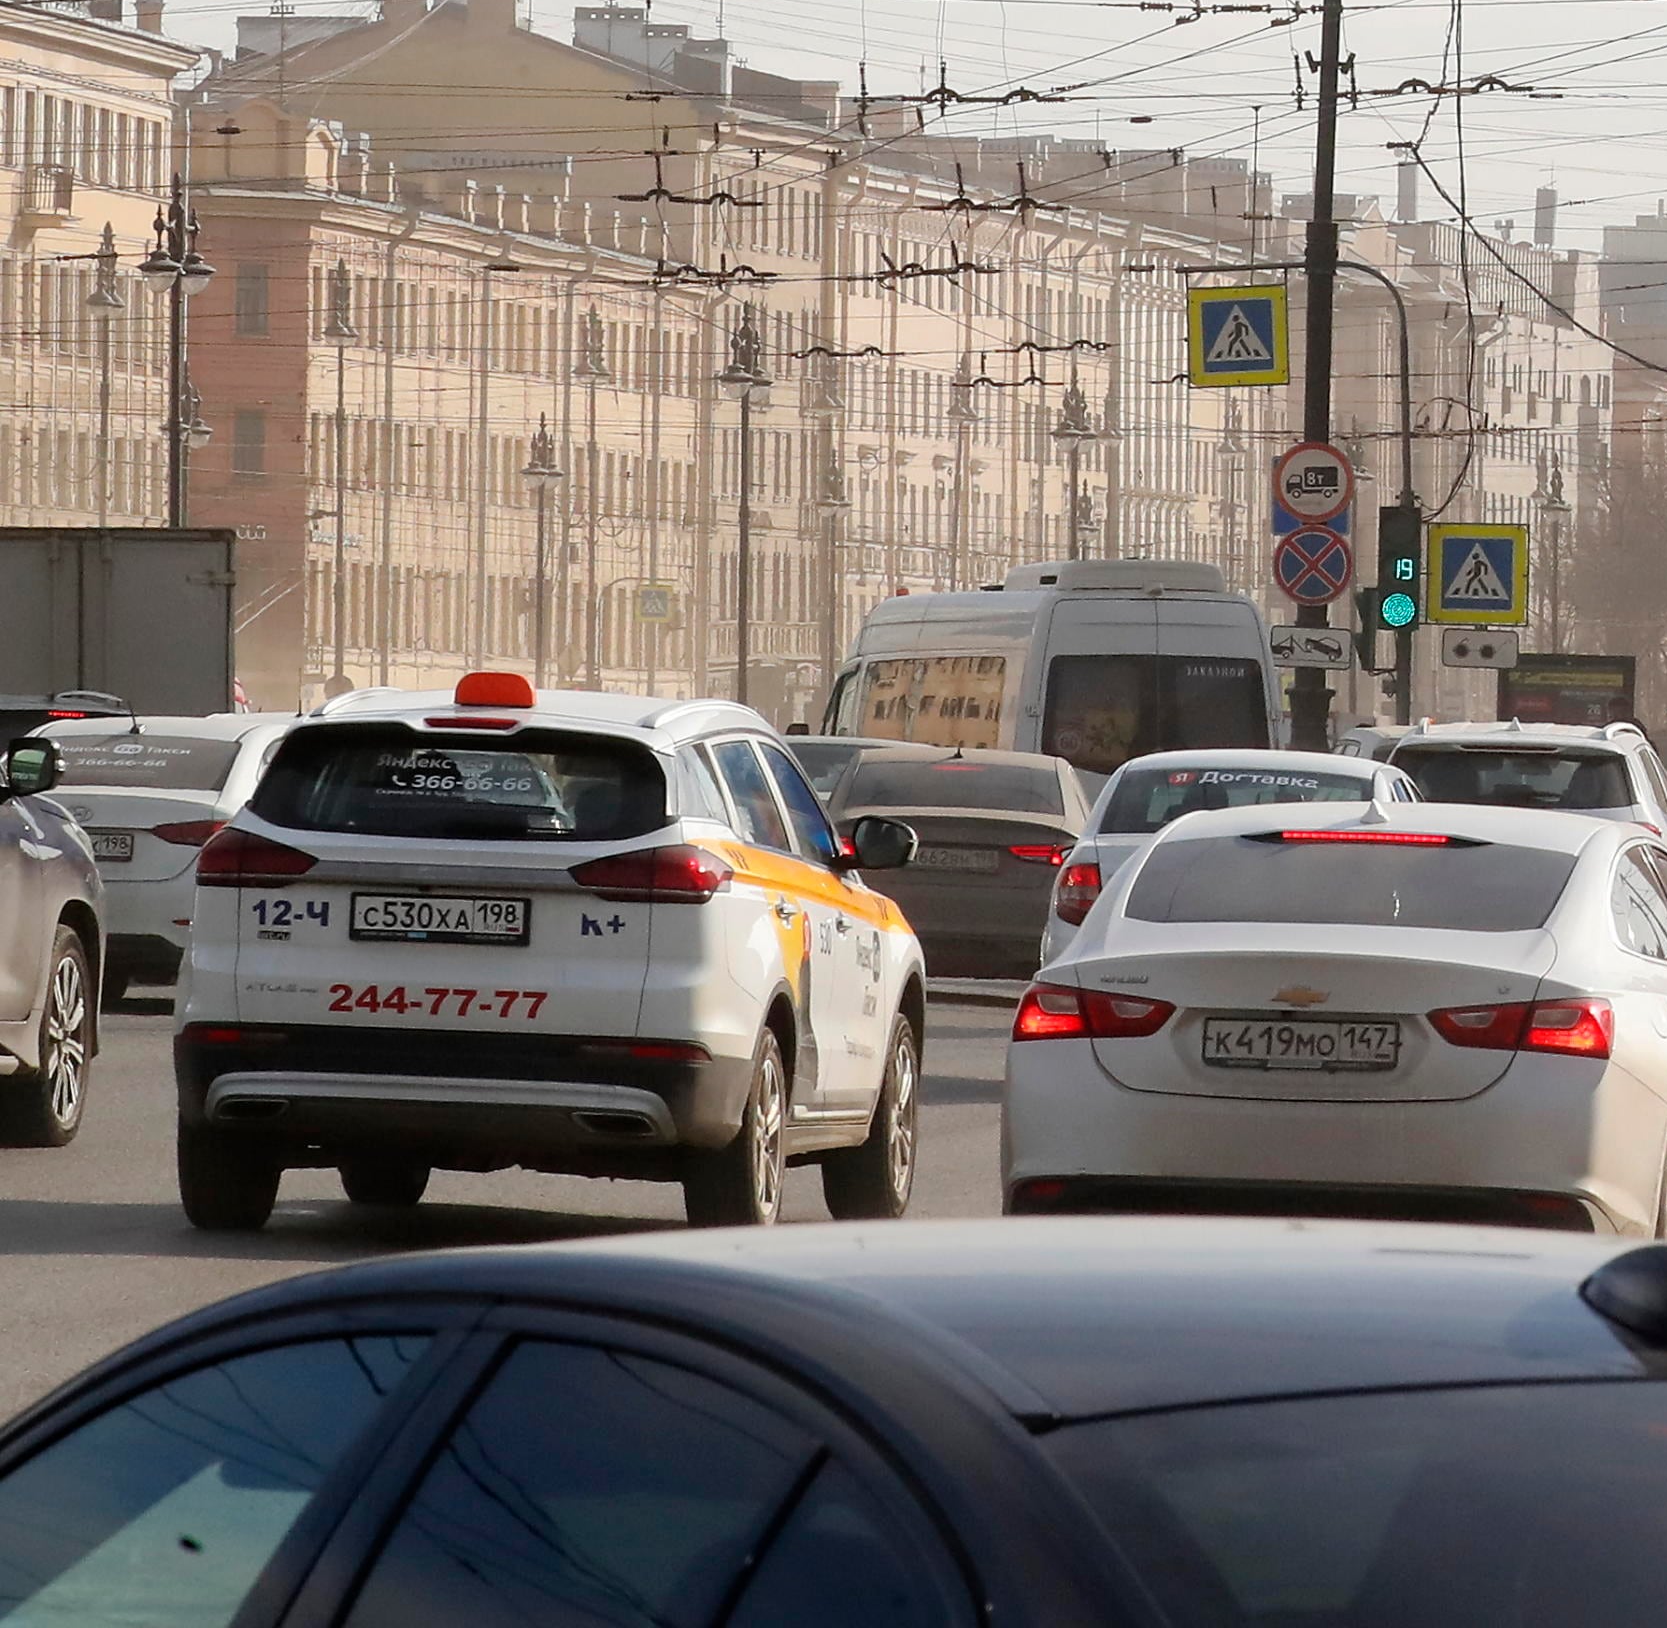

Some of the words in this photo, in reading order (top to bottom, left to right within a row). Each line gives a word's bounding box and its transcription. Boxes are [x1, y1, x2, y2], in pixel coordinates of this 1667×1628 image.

[1396, 558, 1413, 581] 19
[411, 774, 532, 791] 366-66-66
[1198, 770, 1320, 789] Доставка
[328, 983, 549, 1020] 244-77-77
